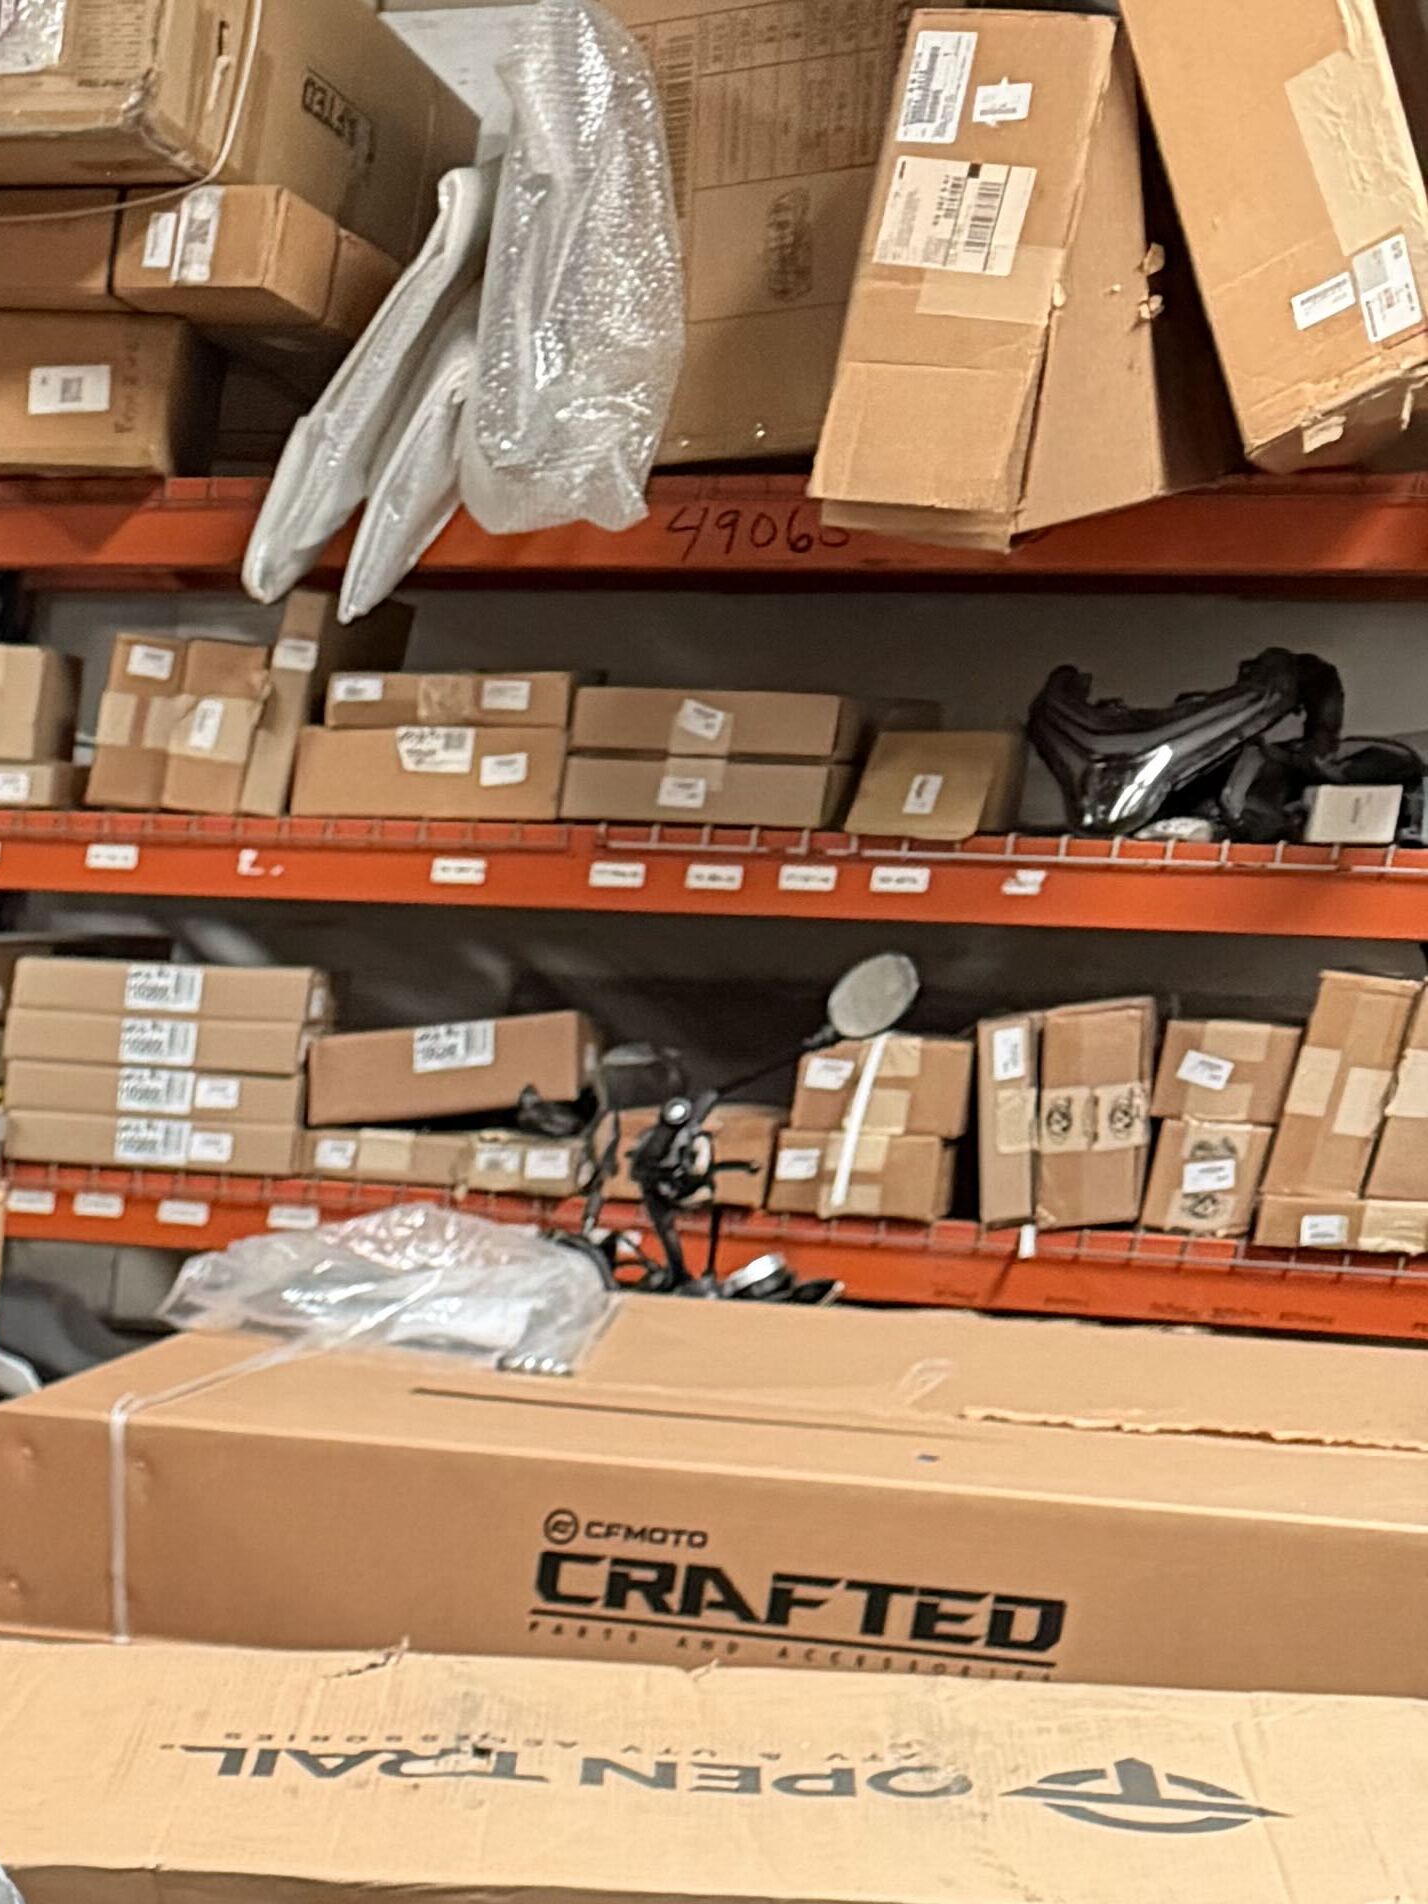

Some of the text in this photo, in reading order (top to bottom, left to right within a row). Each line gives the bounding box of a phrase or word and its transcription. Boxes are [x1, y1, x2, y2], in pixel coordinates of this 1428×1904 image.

[584, 1519, 709, 1550] CFMOTO
[534, 1550, 1067, 1654] CRAFTED
[180, 1746, 973, 1798] OPEN TRAIL
